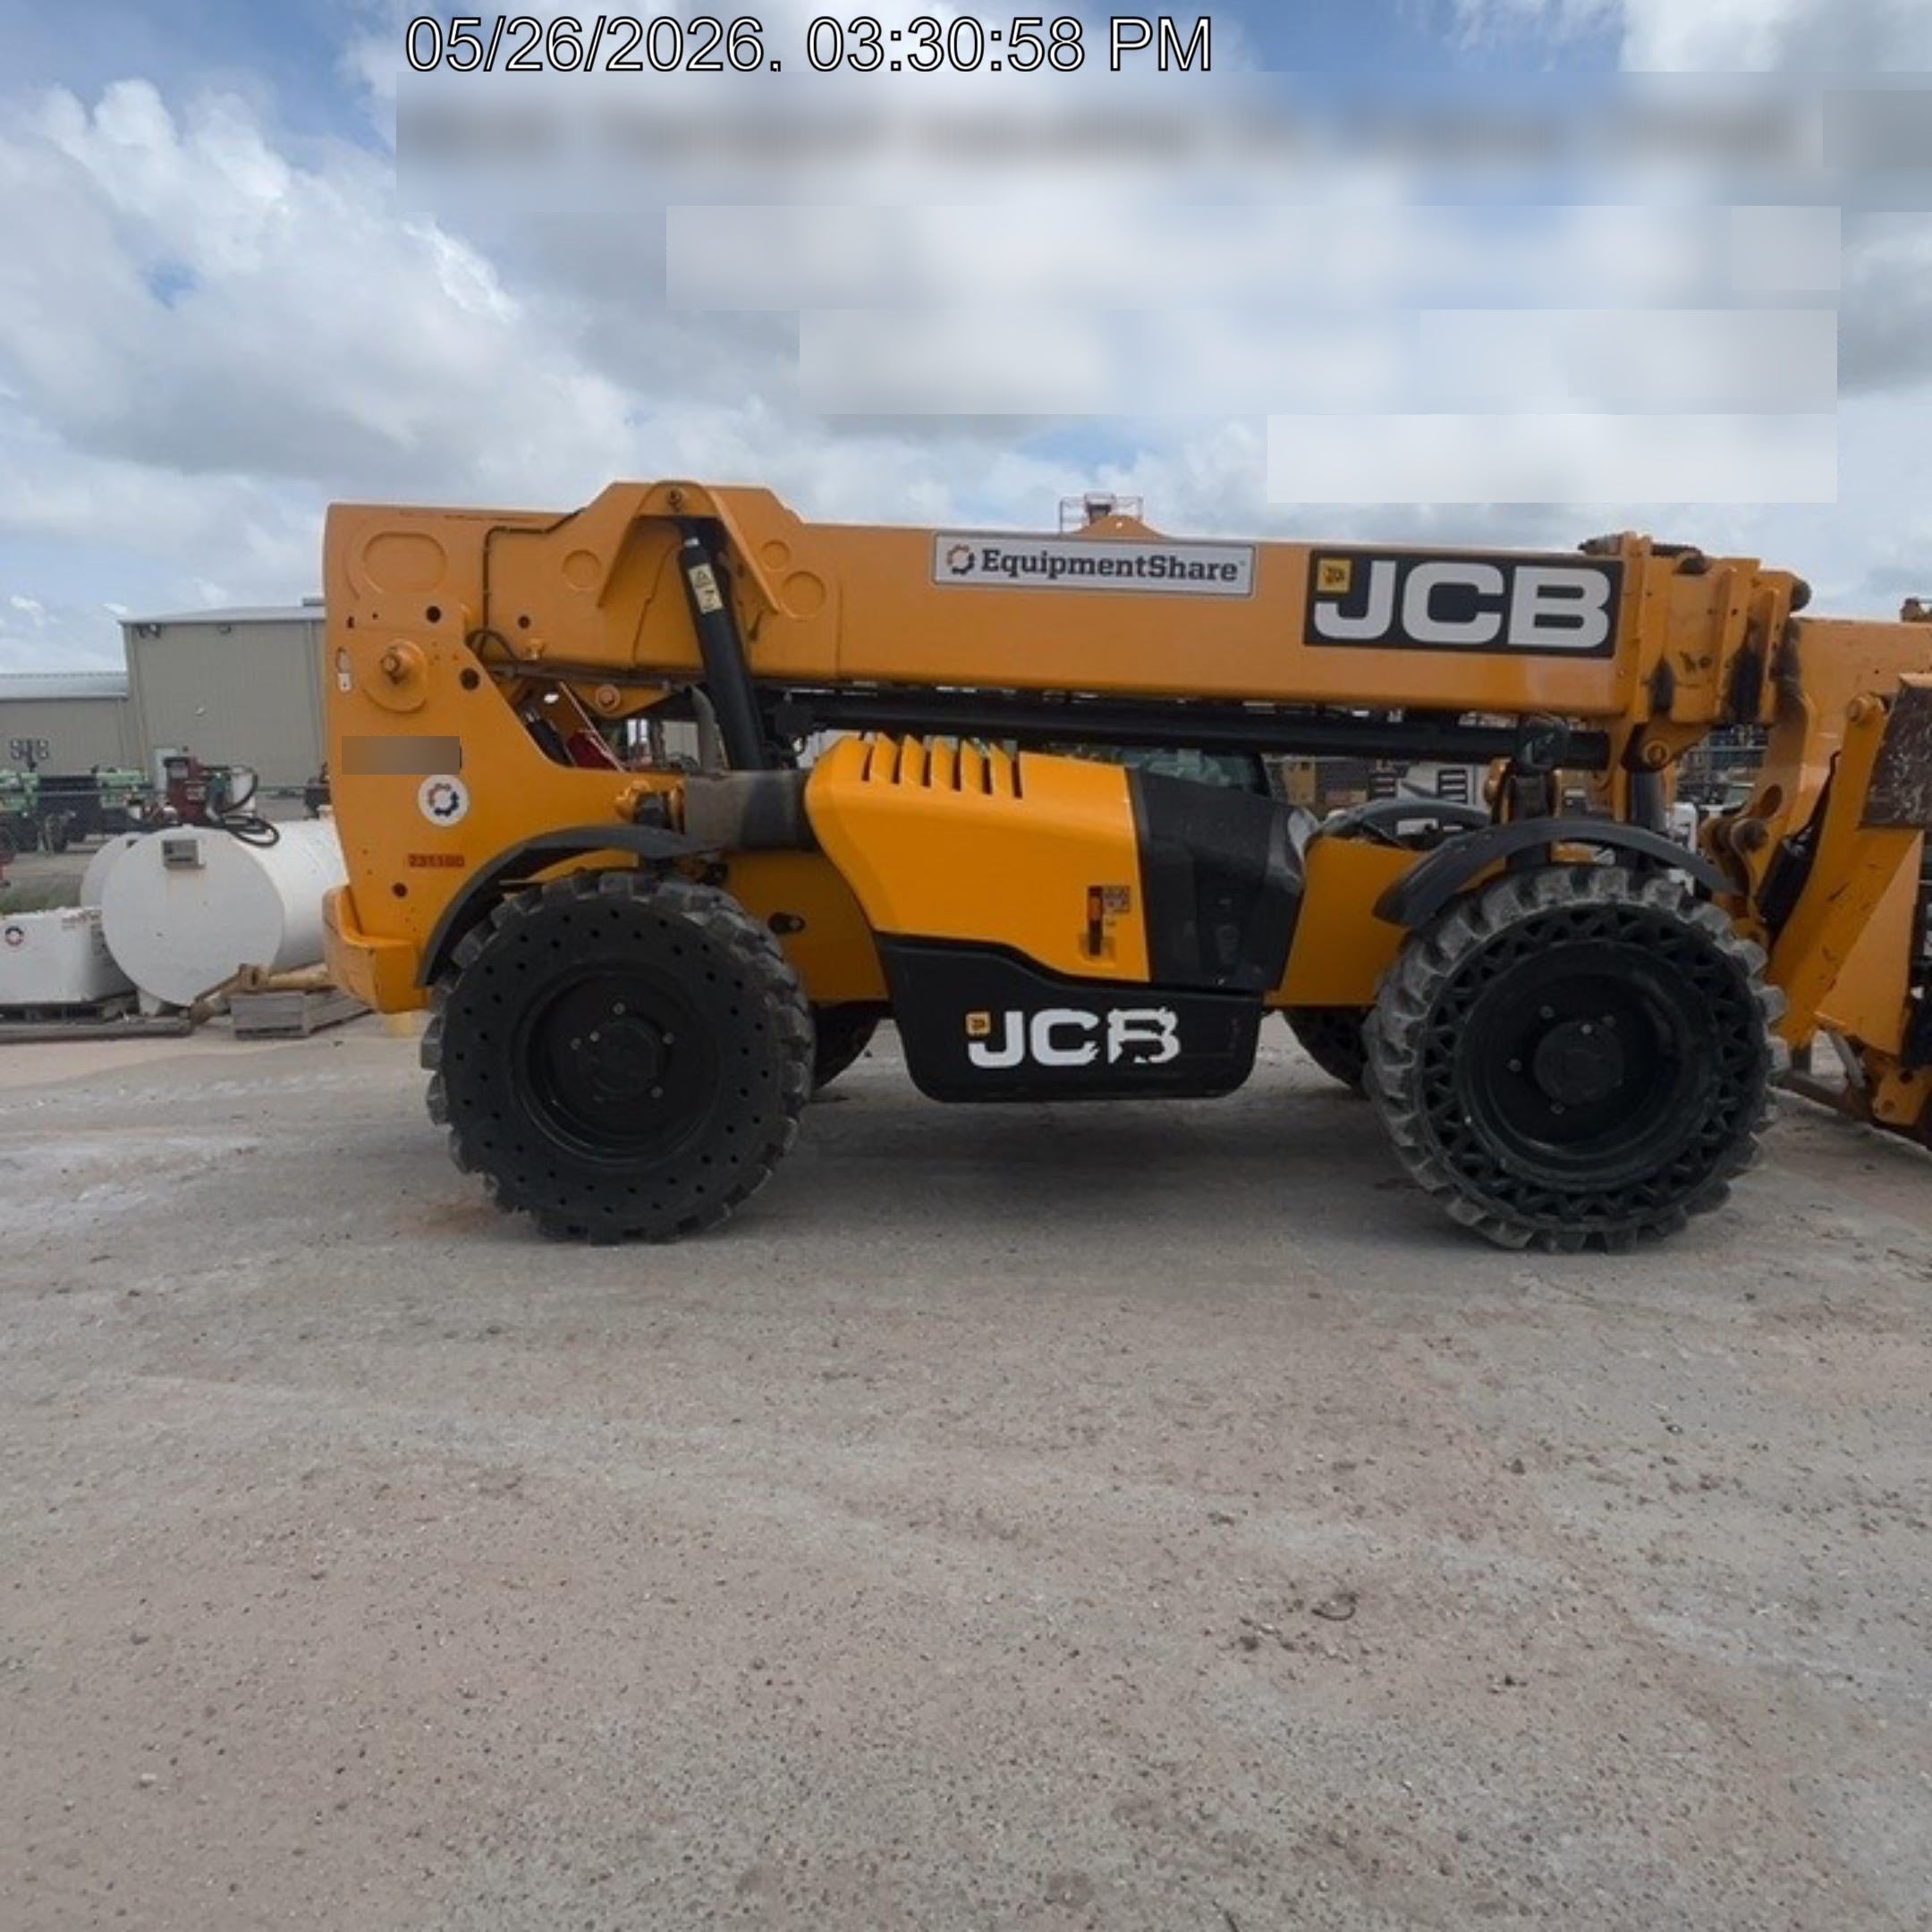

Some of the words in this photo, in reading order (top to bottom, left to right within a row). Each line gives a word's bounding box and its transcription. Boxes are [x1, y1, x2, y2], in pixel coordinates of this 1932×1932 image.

[980, 548, 1239, 581] EquipmentShare
[1313, 559, 1611, 648] JCB
[968, 1007, 1182, 1069] JCB
